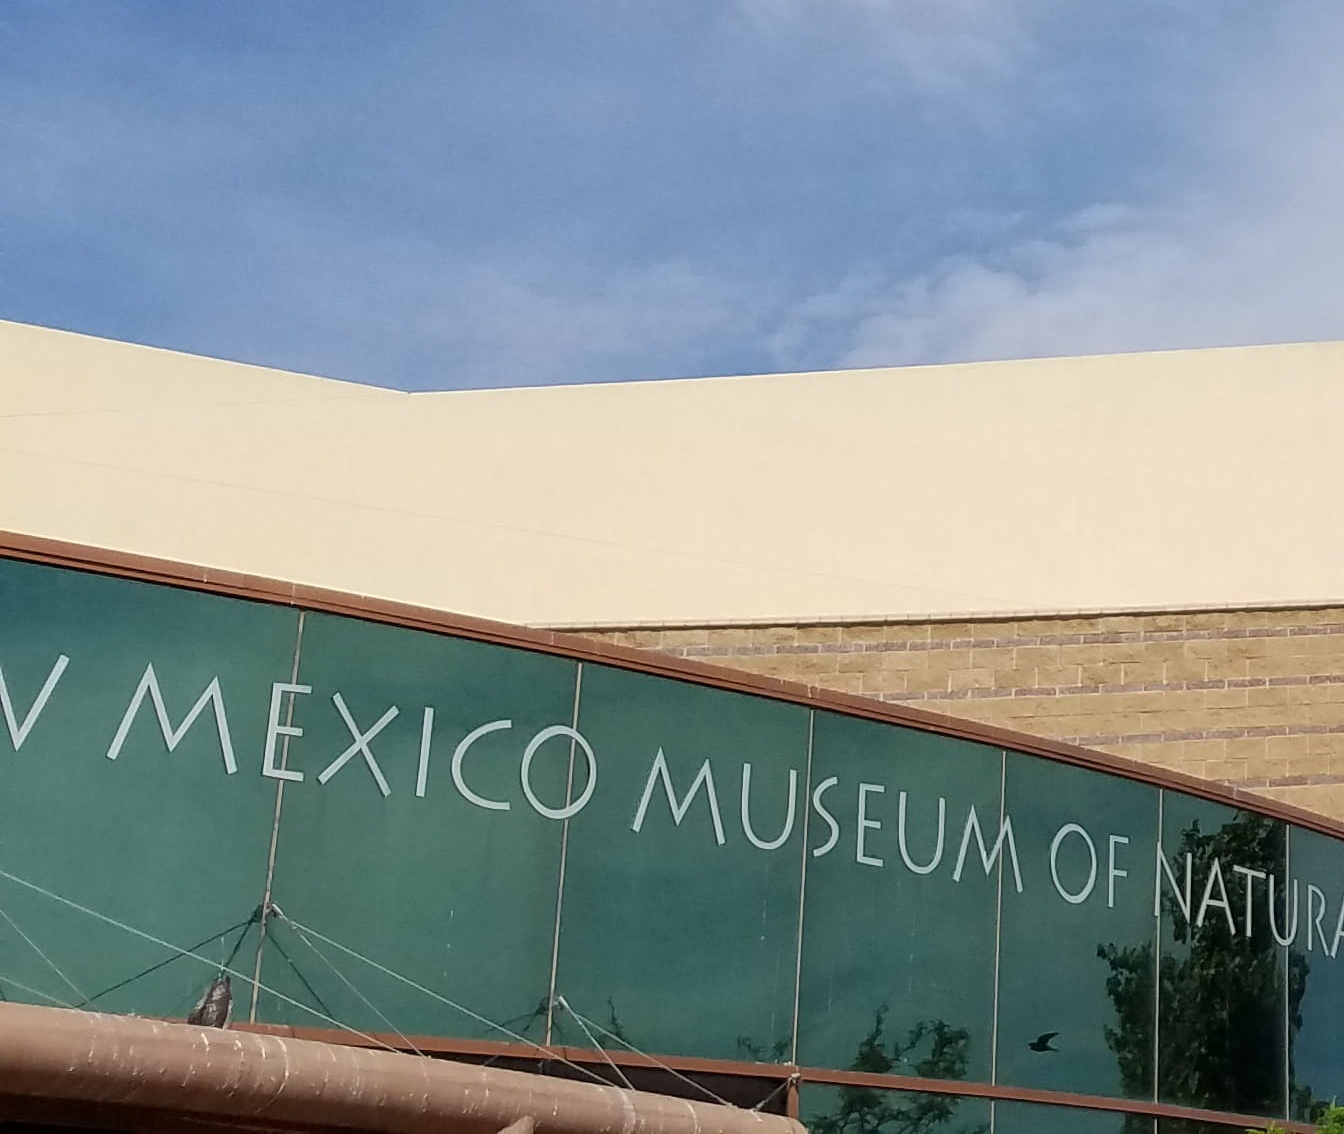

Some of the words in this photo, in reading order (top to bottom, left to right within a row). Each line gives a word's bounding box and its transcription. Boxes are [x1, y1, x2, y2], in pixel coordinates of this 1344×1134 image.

[106, 662, 597, 821] MEXICO
[630, 746, 1024, 894] MUSEUM
[1050, 822, 1130, 908] OF
